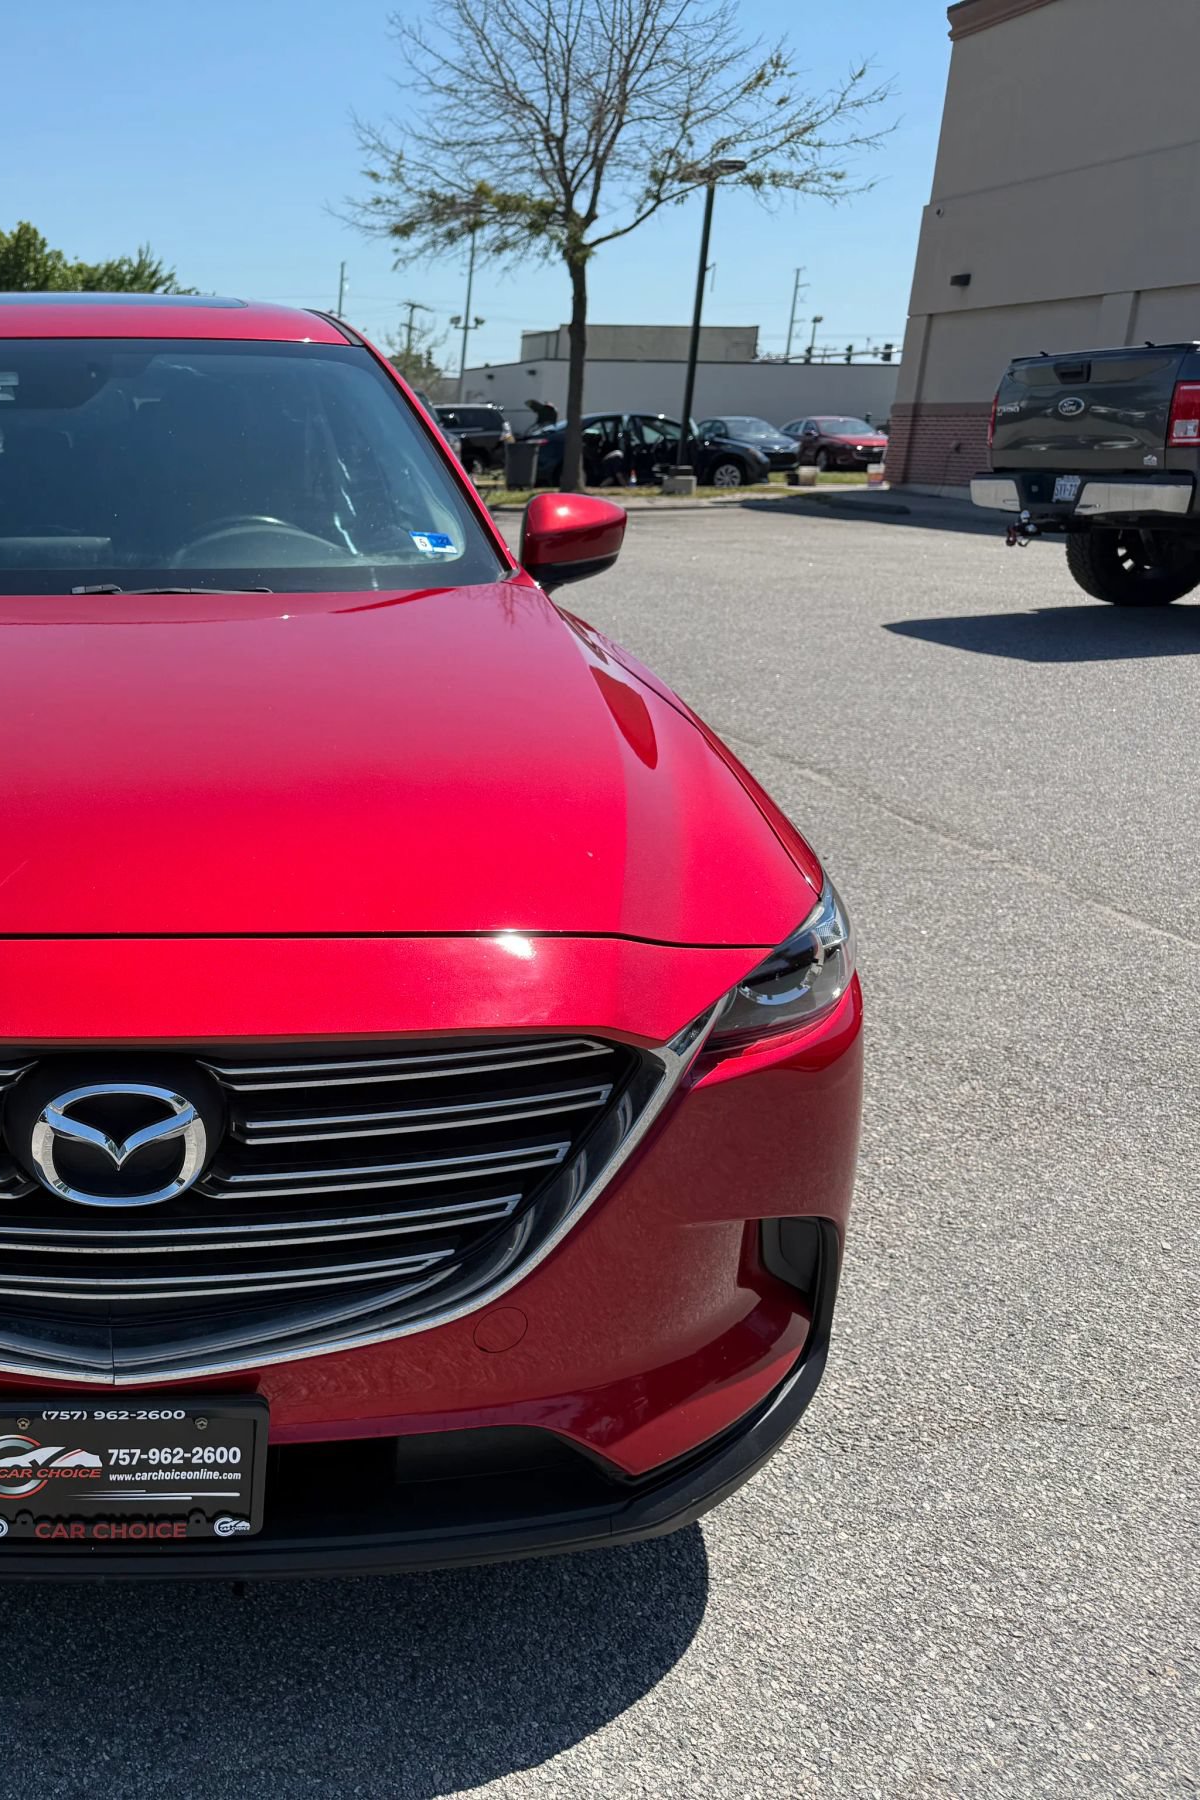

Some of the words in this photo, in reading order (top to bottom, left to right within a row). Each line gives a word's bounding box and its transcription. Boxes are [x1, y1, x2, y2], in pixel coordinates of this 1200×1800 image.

[42, 1410, 87, 1421] (757)
[93, 1410, 186, 1421] 962-2600
[108, 1446, 241, 1465] 757-962-2600
[36, 1468, 102, 1478] CHOICE
[109, 1469, 241, 1481] www.carchoiceonline.com
[35, 1522, 86, 1539] CAR
[92, 1522, 187, 1539] CHOICE
